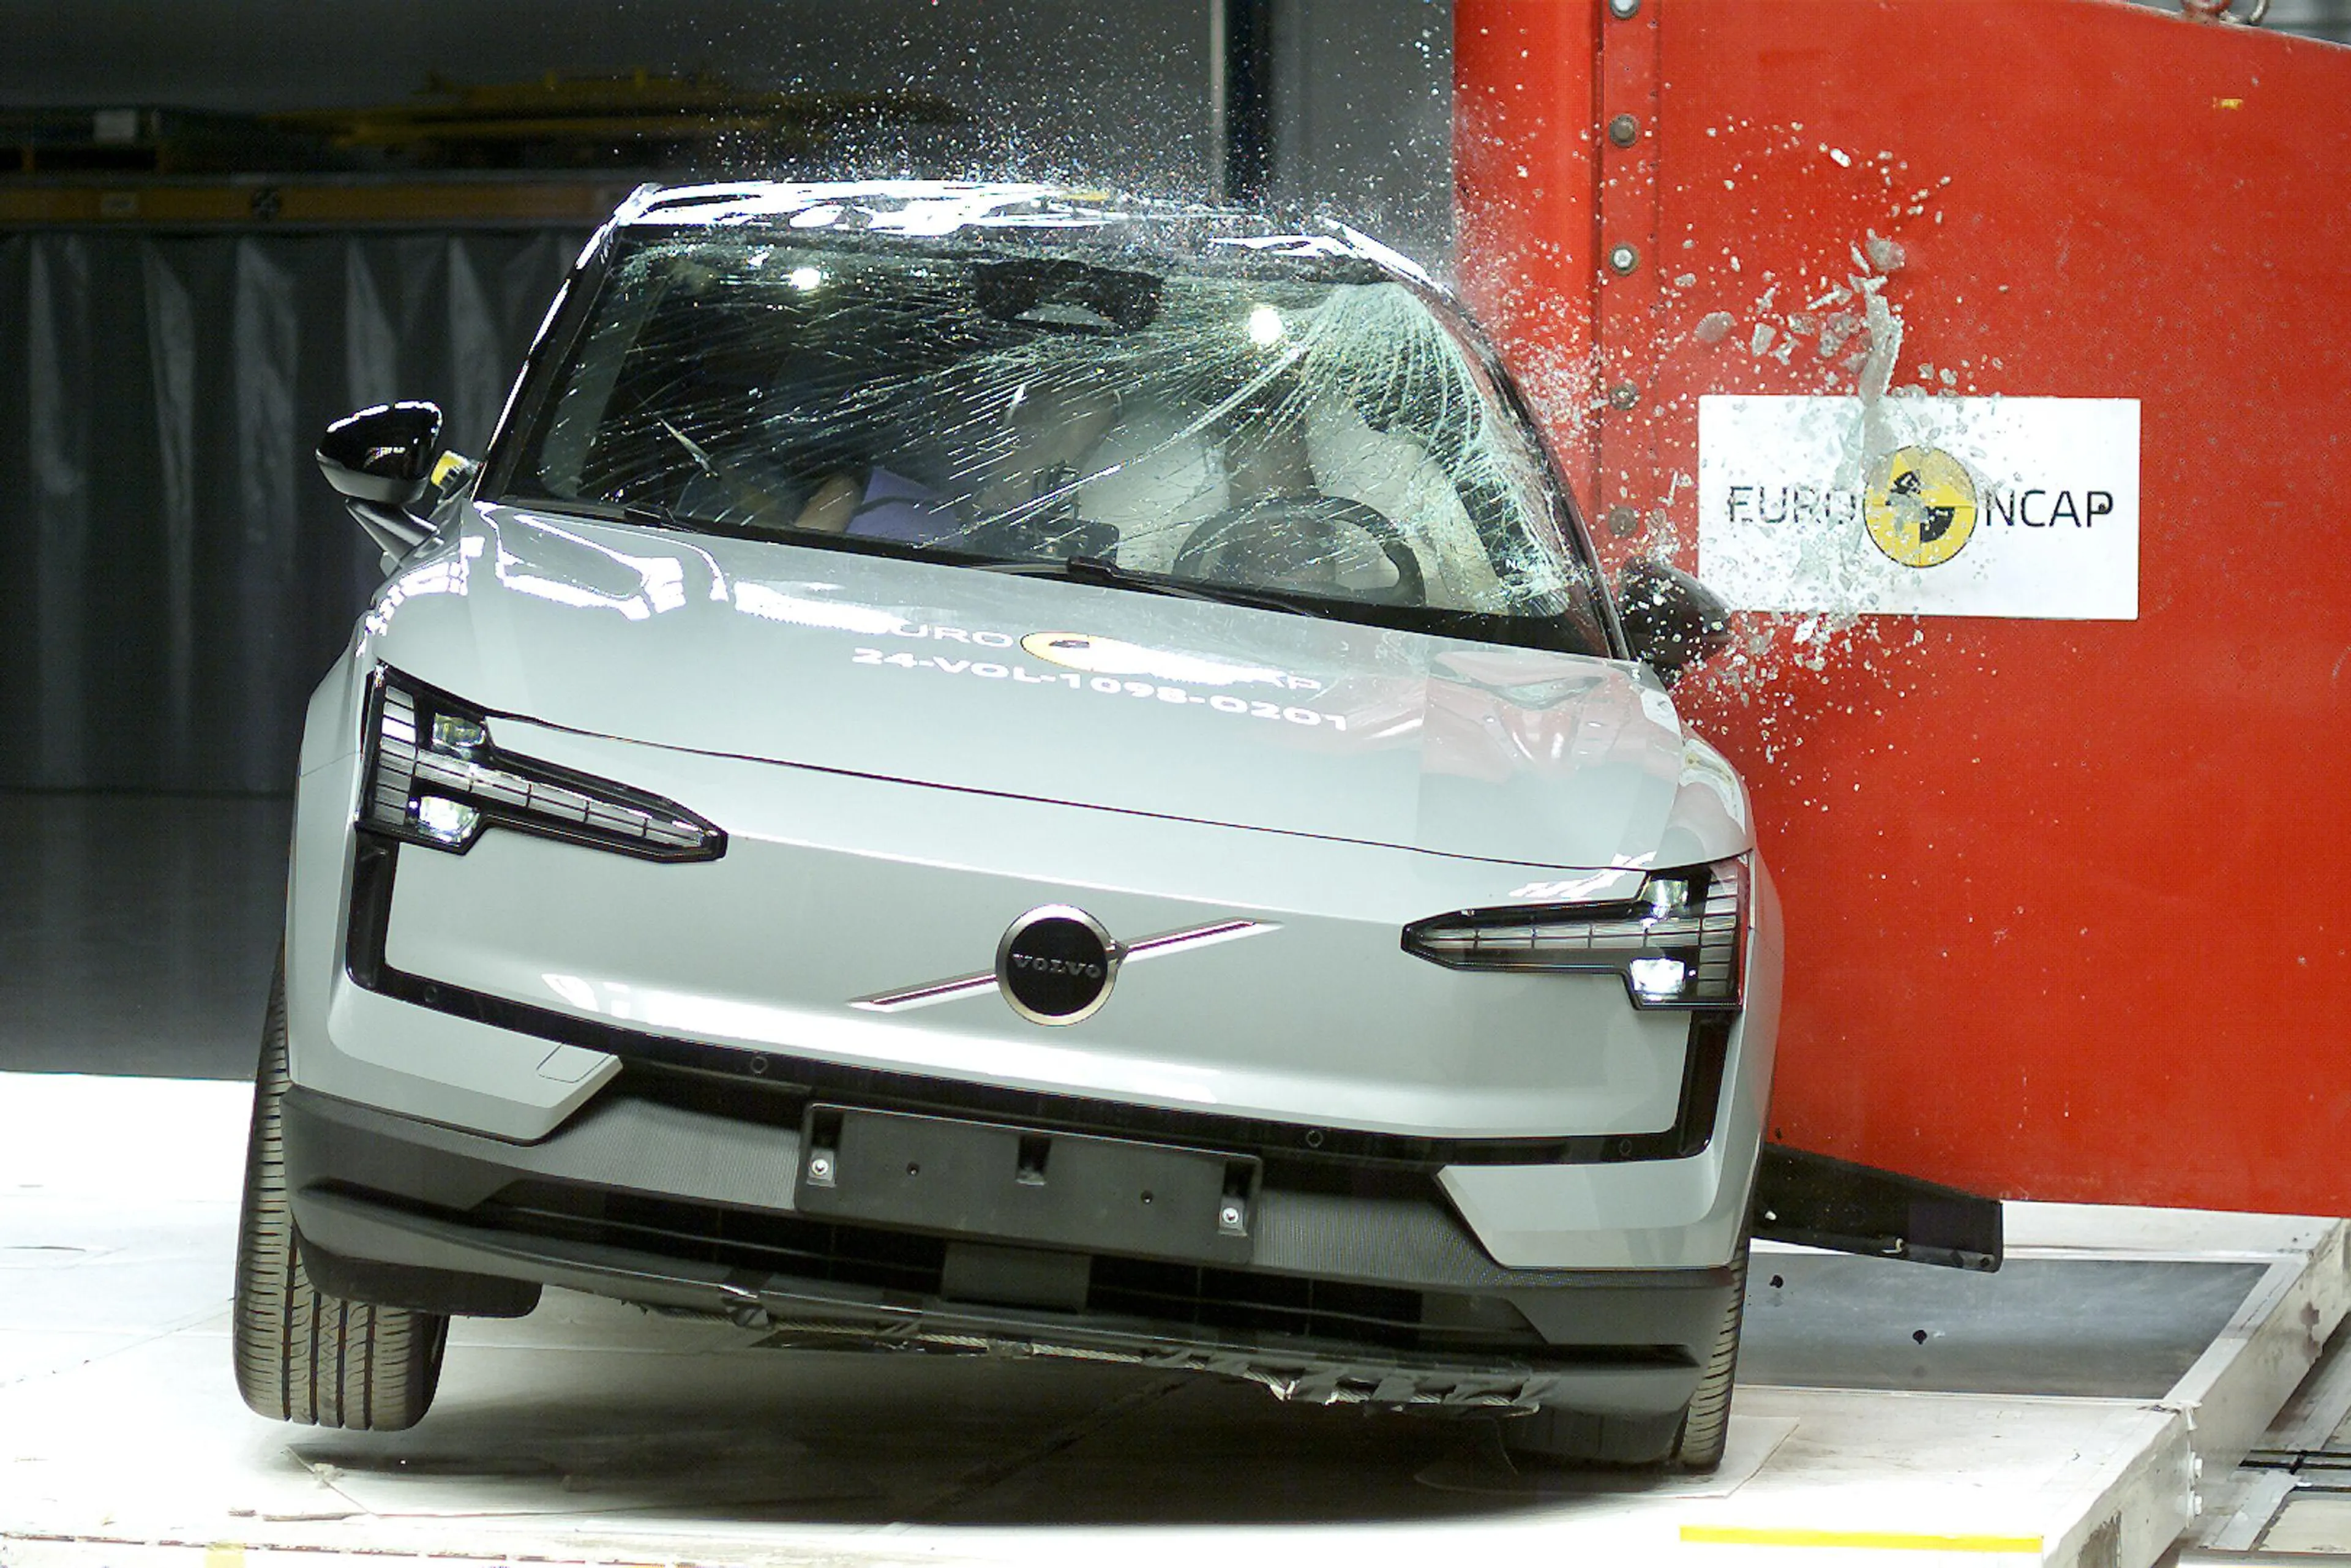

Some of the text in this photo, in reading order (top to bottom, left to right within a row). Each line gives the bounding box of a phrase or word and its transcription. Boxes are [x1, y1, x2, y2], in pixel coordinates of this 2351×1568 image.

[1986, 489, 2113, 528] NCAP
[856, 617, 1014, 648] URO
[852, 647, 1347, 732] 24-VOL-1098-0201
[1013, 953, 1101, 979] VOLVO
